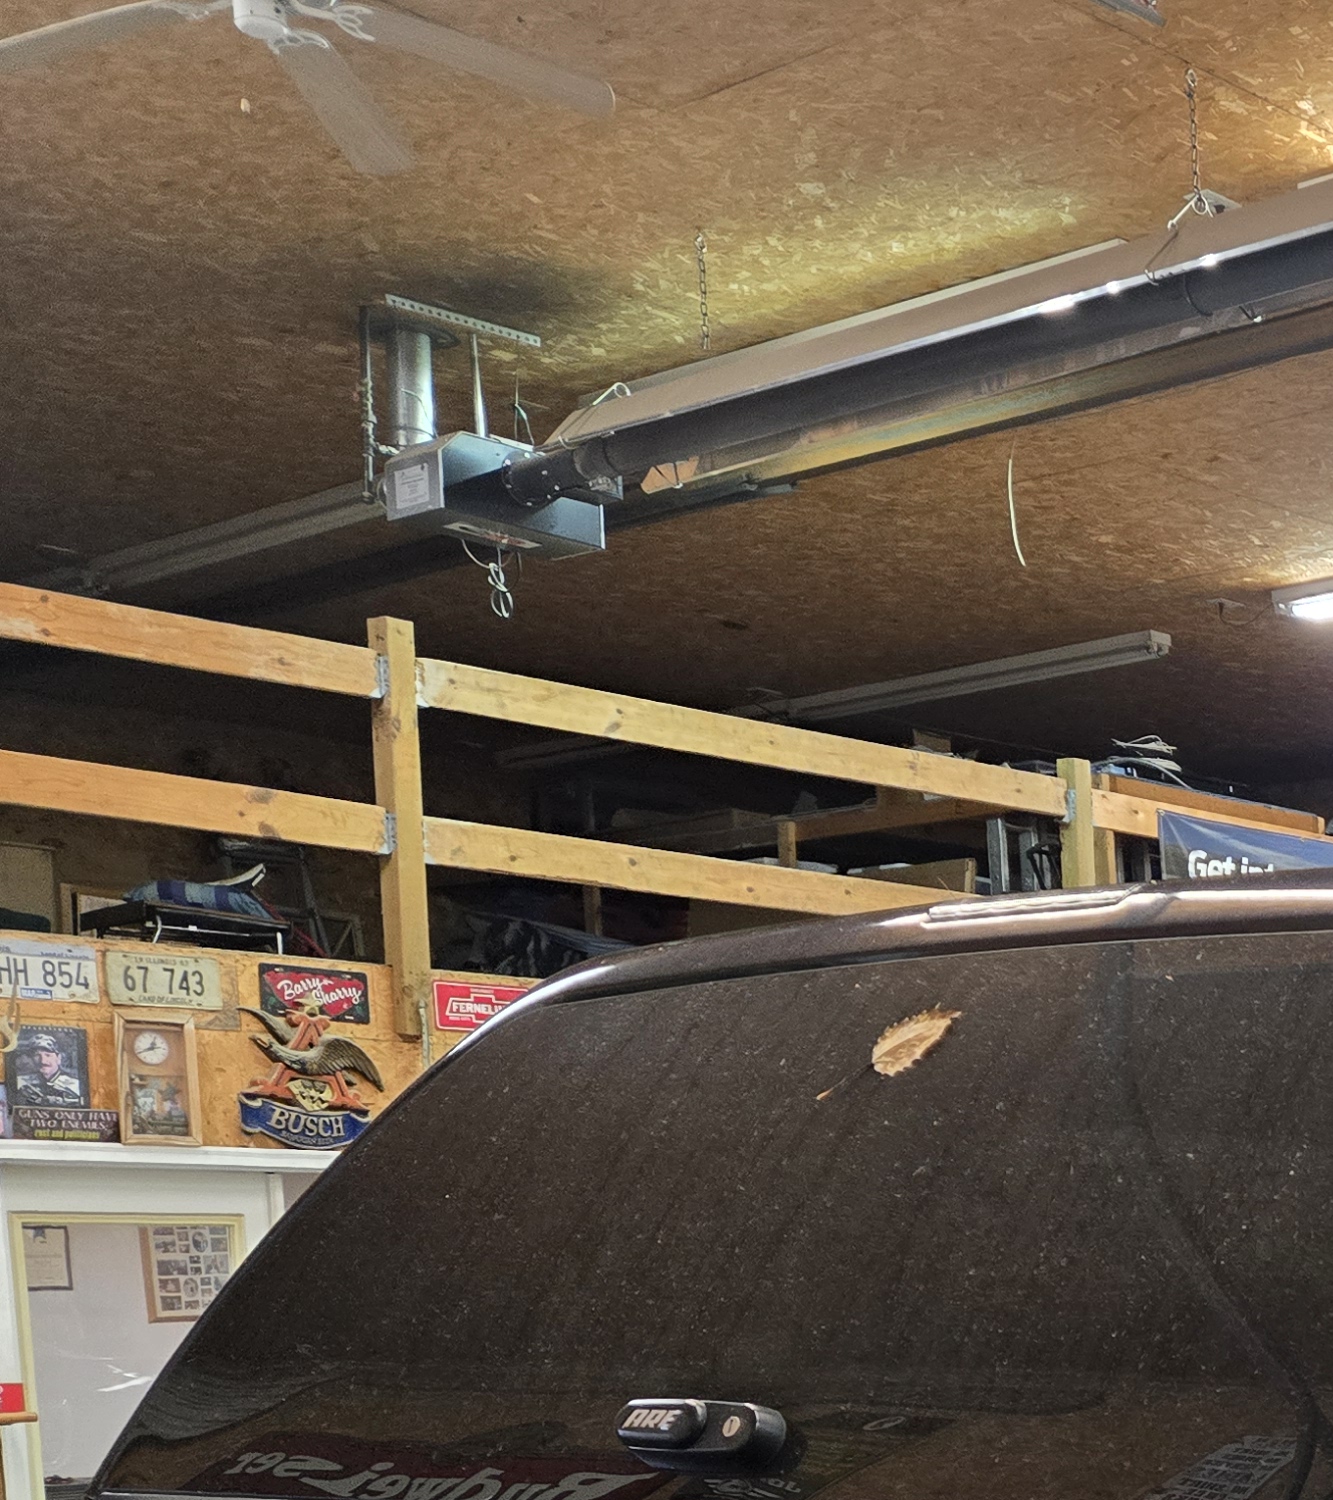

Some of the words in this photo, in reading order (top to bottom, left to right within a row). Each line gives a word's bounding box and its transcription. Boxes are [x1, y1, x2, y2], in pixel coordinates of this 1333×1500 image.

[1187, 849, 1236, 879] Get
[41, 960, 90, 990] 854
[123, 964, 149, 994] 67
[162, 967, 206, 997] 743
[276, 976, 334, 1001] Barry
[18, 1109, 50, 1120] GUNS
[54, 1109, 85, 1121] ONLY
[30, 1119, 57, 1129] TWO
[266, 1104, 346, 1138] BUSCH
[621, 1408, 685, 1432] ARE
